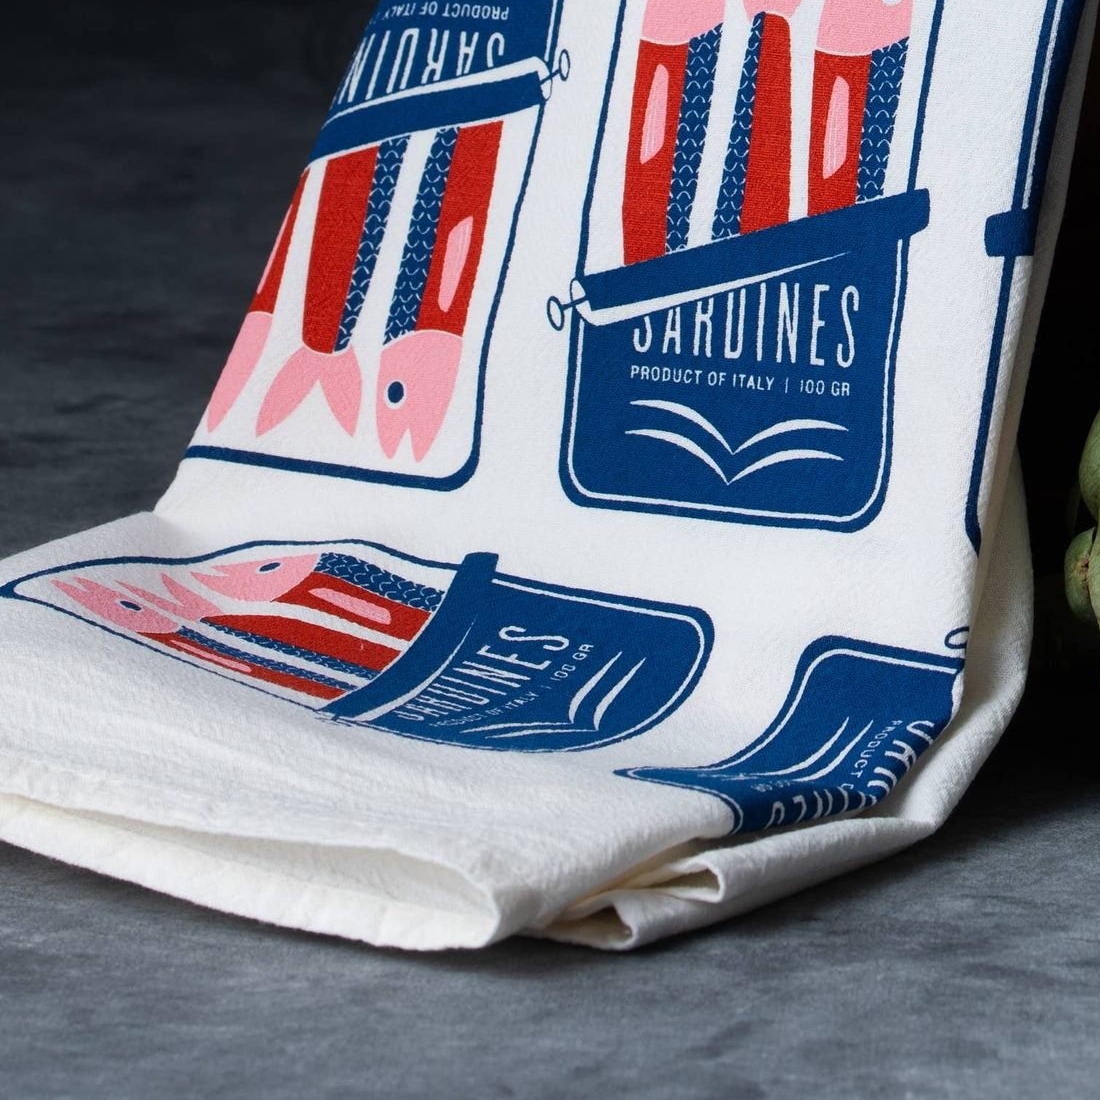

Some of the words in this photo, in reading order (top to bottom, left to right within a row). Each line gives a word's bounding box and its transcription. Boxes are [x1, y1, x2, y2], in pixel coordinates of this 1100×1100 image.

[418, 1, 439, 16] OF
[442, 3, 509, 20] PRODUCT
[630, 365, 702, 385] PRODUCT
[707, 372, 727, 386] OF
[733, 373, 774, 391] ITALY
[800, 379, 825, 395] 100
[831, 381, 851, 397] GR
[504, 691, 539, 710] ITALY
[550, 664, 576, 681] 100
[572, 644, 595, 660] GR
